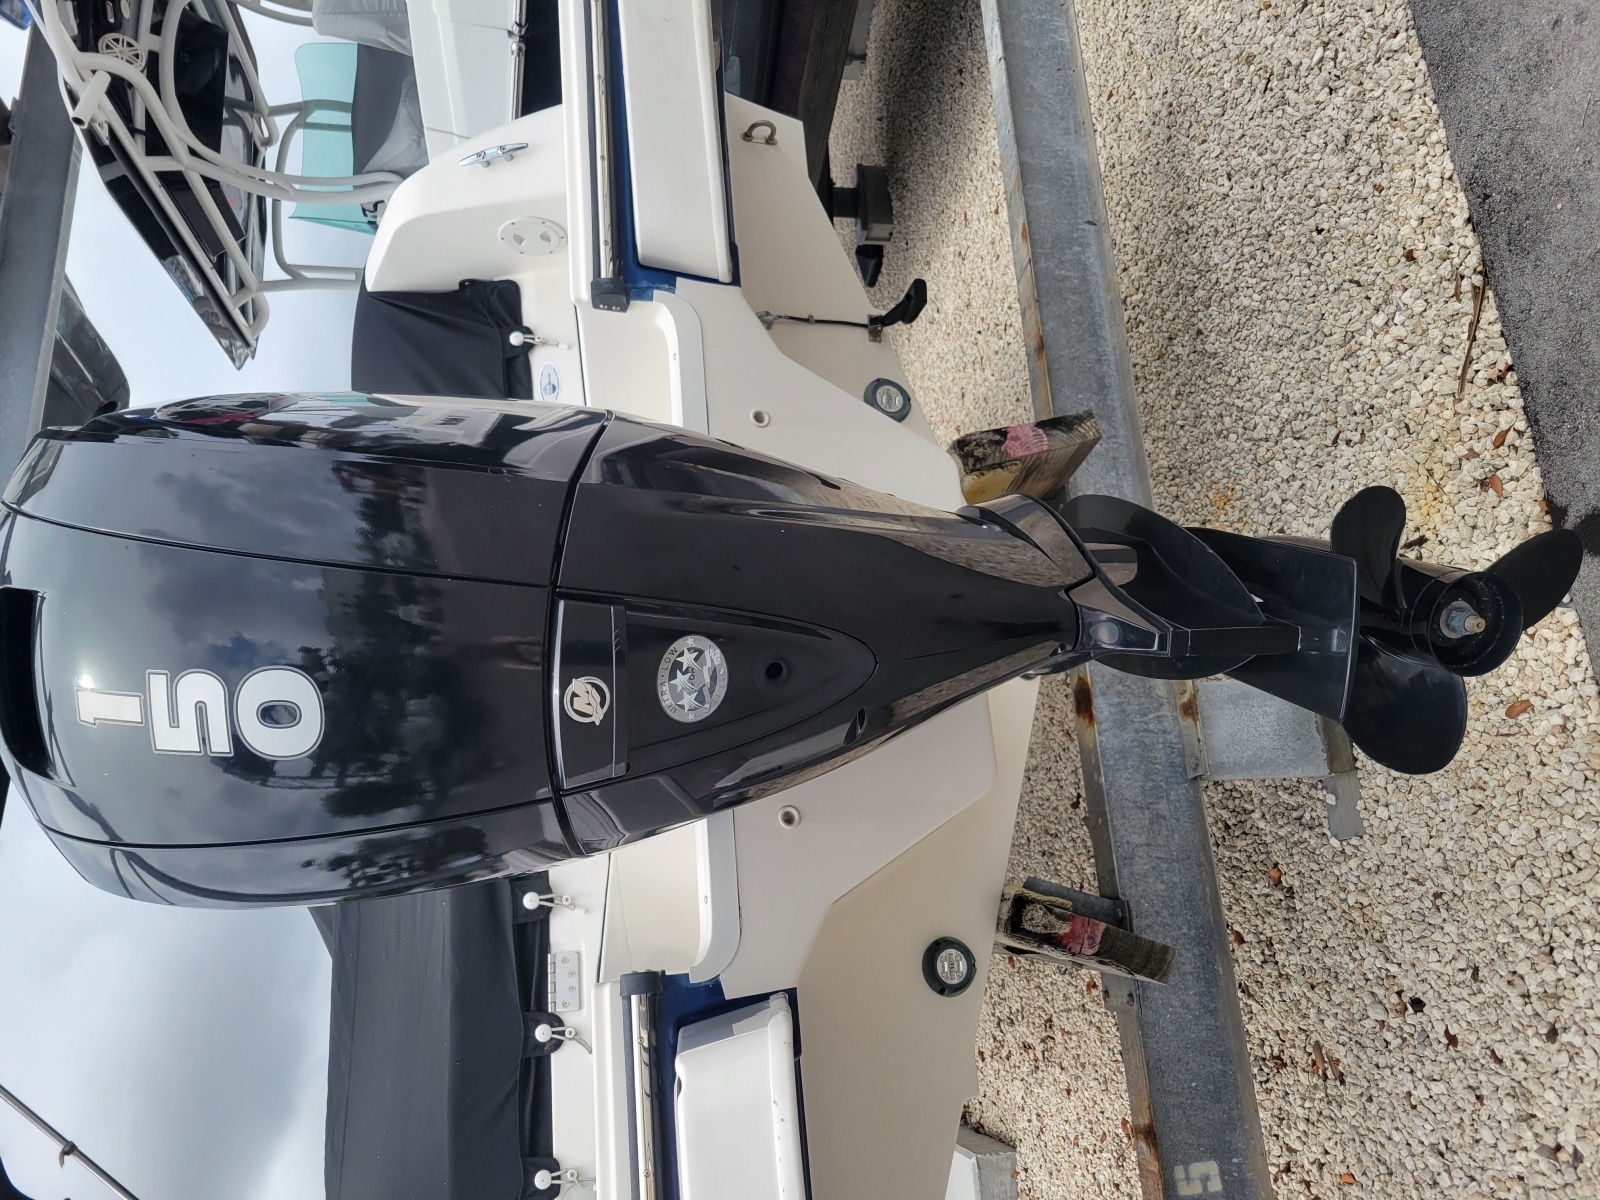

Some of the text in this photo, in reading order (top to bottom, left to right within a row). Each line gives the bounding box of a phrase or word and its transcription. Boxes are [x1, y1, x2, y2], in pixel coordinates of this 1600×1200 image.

[73, 665, 325, 760] 150
[659, 646, 678, 714] ULTRA LOW
